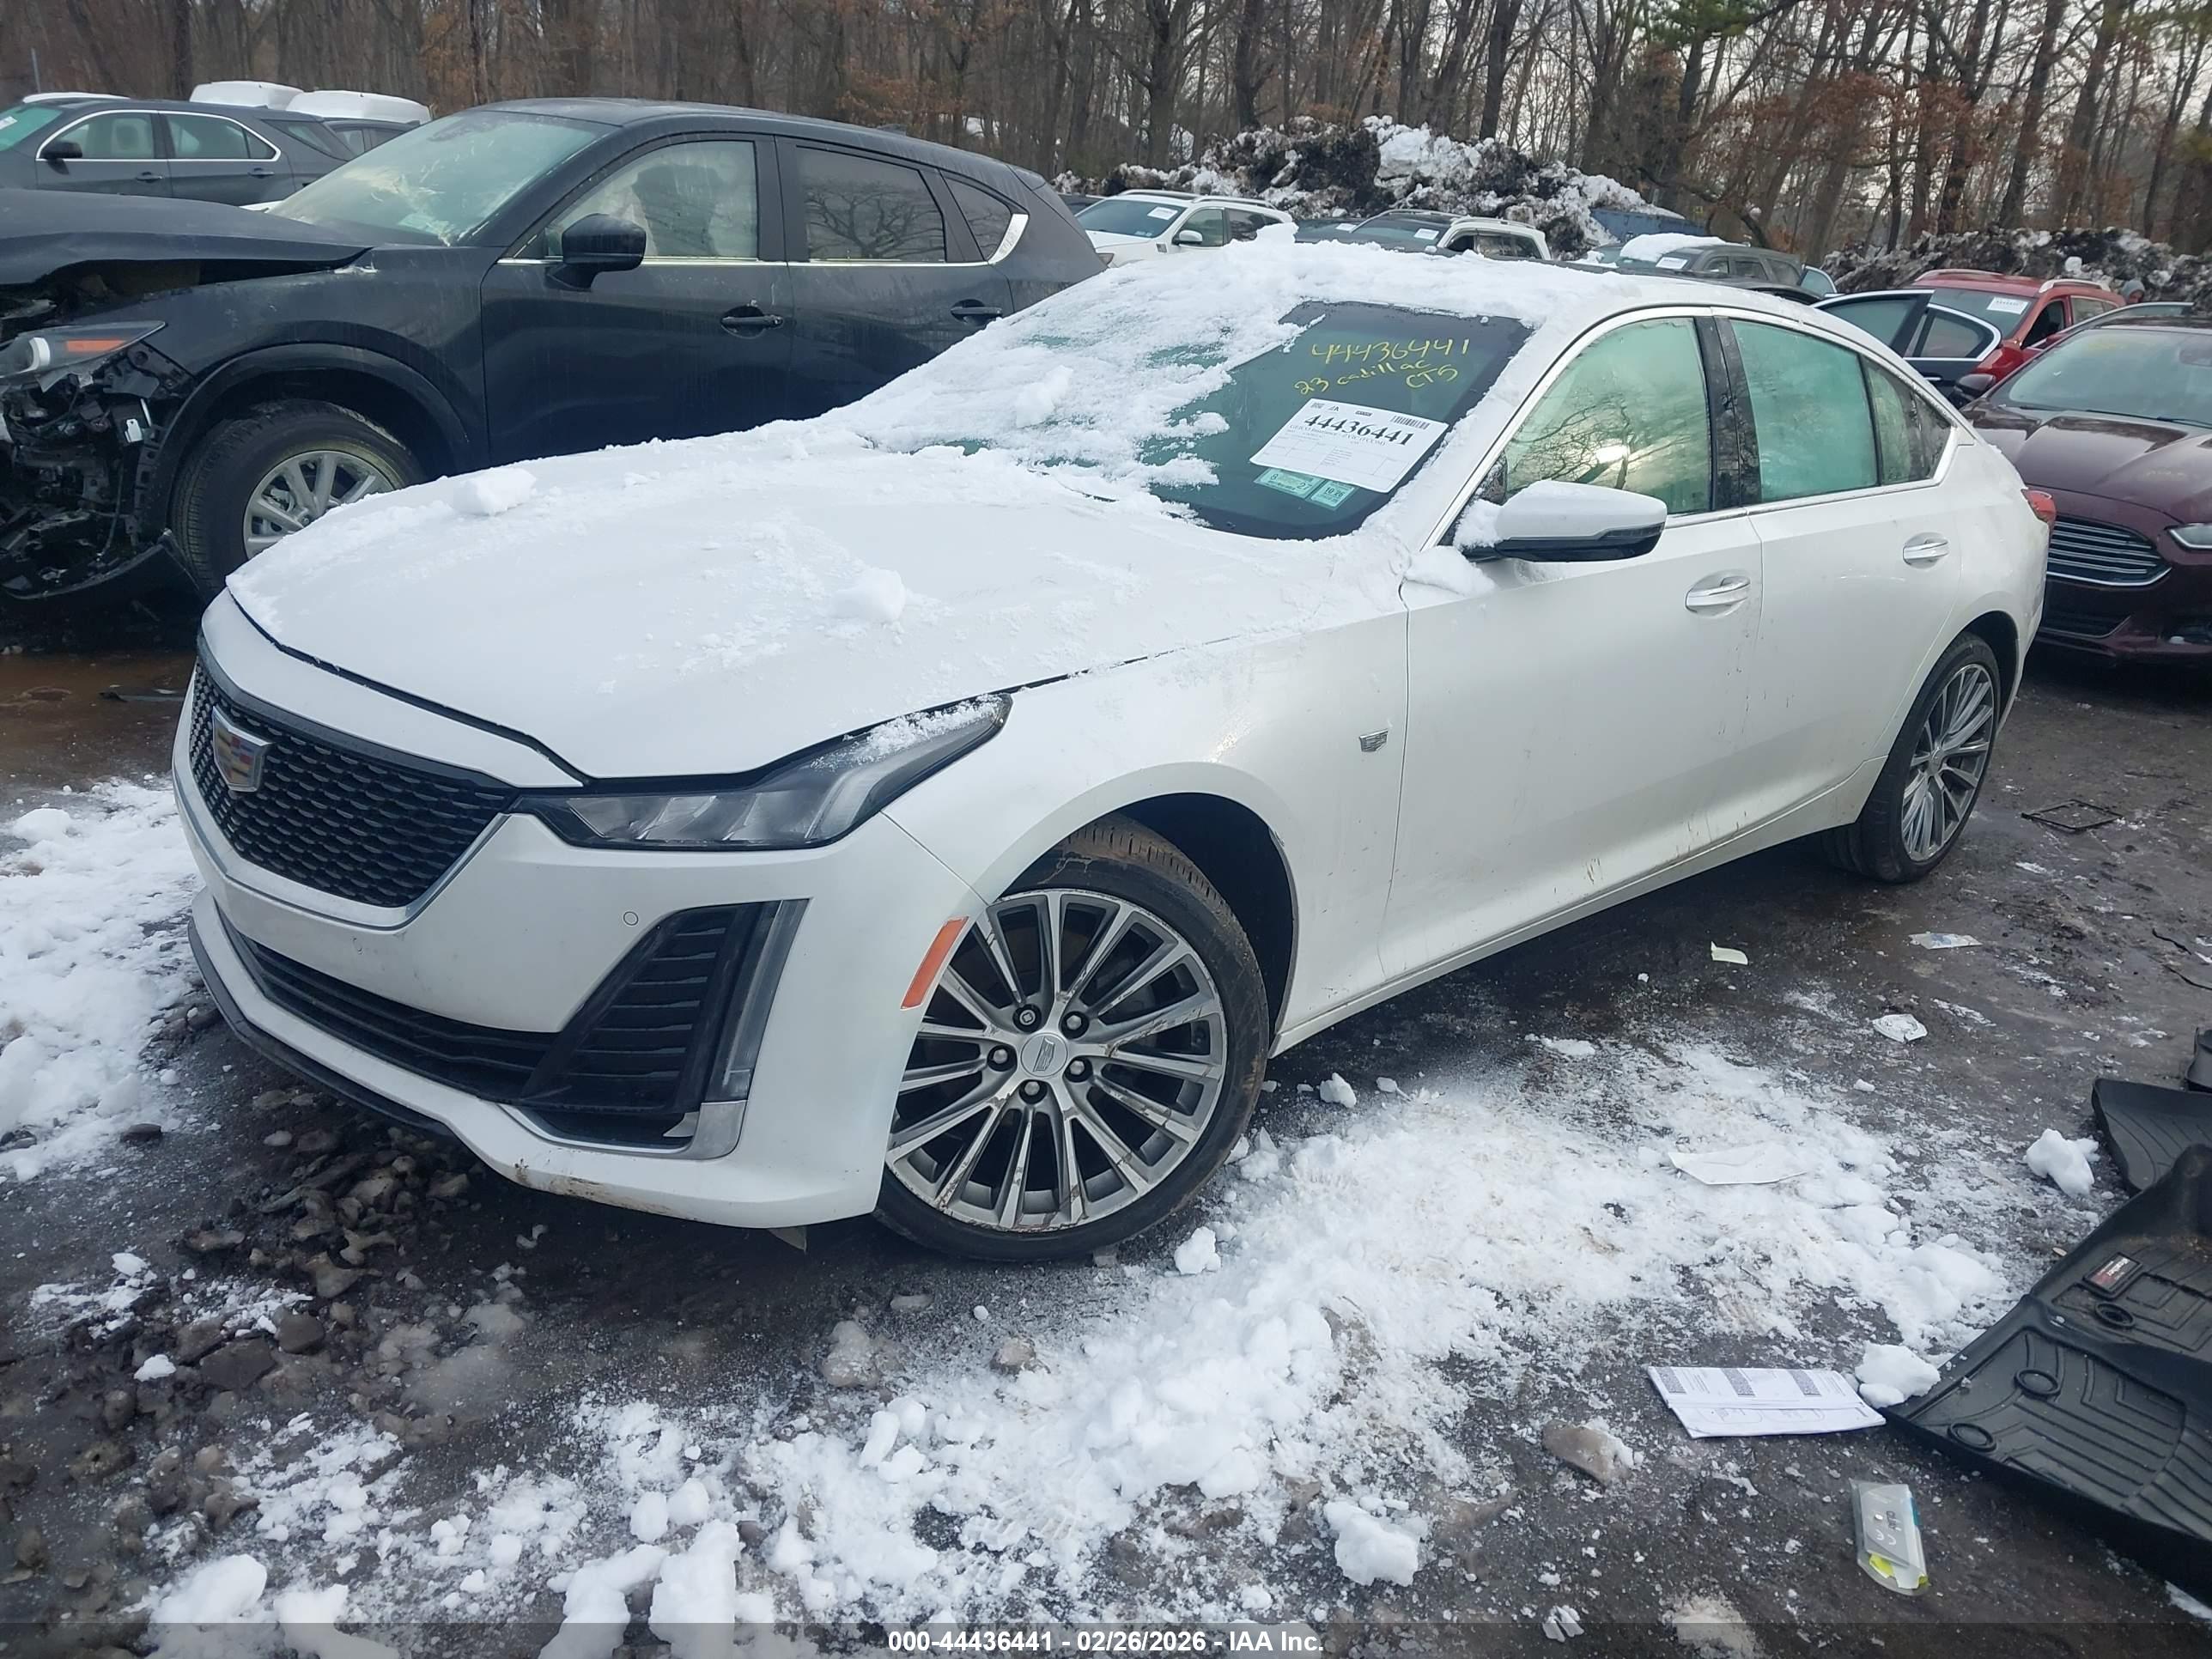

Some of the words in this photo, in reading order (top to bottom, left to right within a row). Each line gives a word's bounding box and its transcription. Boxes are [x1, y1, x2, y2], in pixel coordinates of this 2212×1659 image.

[1311, 338, 1470, 365] 44436441
[1294, 377, 1329, 395] 23
[1304, 414, 1415, 447] 44436441
